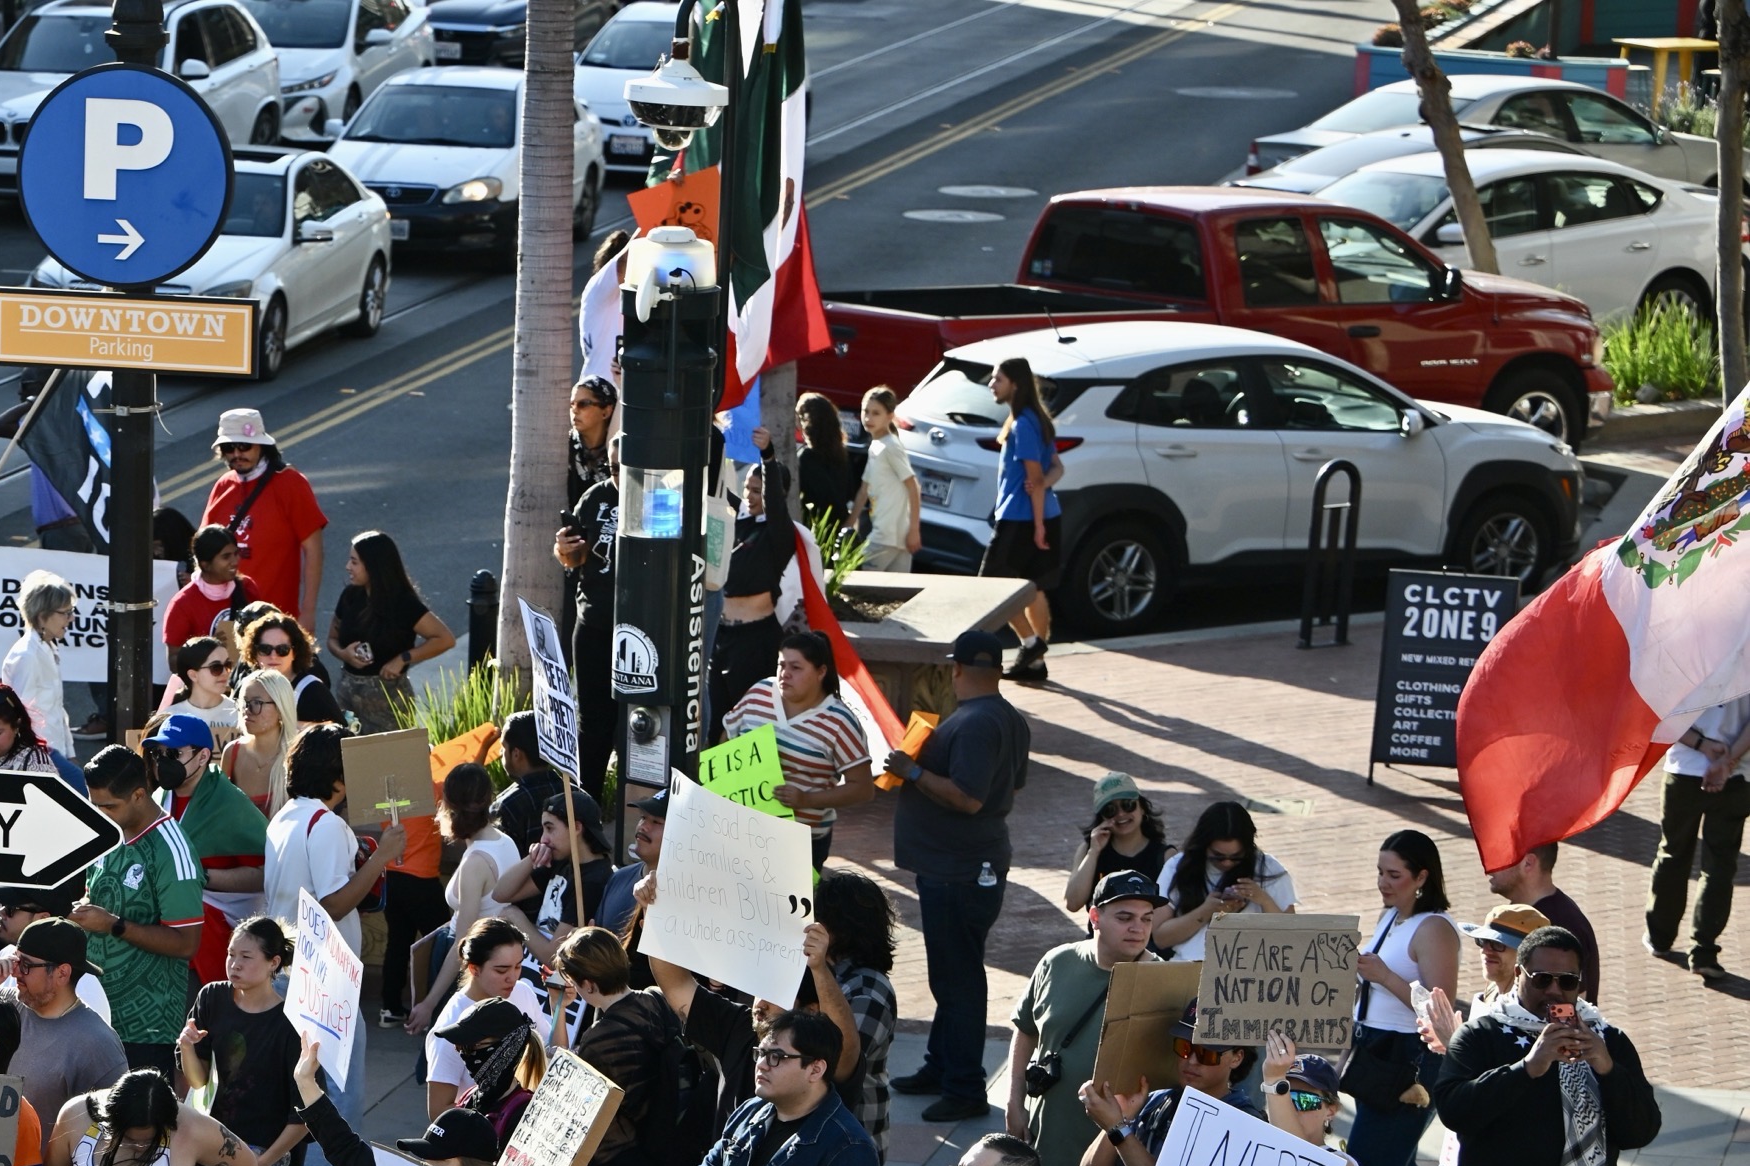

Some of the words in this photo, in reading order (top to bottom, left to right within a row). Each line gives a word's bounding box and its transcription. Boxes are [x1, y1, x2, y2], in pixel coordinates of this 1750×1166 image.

[84, 97, 174, 200] P
[19, 304, 226, 337] DOWNTOWN
[90, 337, 153, 361] Parking
[1404, 584, 1502, 608] CLCTV
[686, 553, 705, 754] Asistencia
[1401, 653, 1423, 663] NEW
[1425, 655, 1456, 666] MIXED
[1396, 680, 1461, 693] CLOTHING
[1395, 694, 1433, 705] GIFTS
[1393, 720, 1419, 731] ART
[1390, 746, 1428, 758] MORE
[1391, 734, 1441, 746] COFFEE
[301, 899, 326, 941] DOES
[1213, 931, 1248, 971] WE
[1253, 938, 1293, 972] ARE
[1301, 939, 1318, 974] A
[1214, 973, 1300, 1007] NATION
[1311, 981, 1339, 1007] OF
[298, 966, 351, 1047] JUSTICE?
